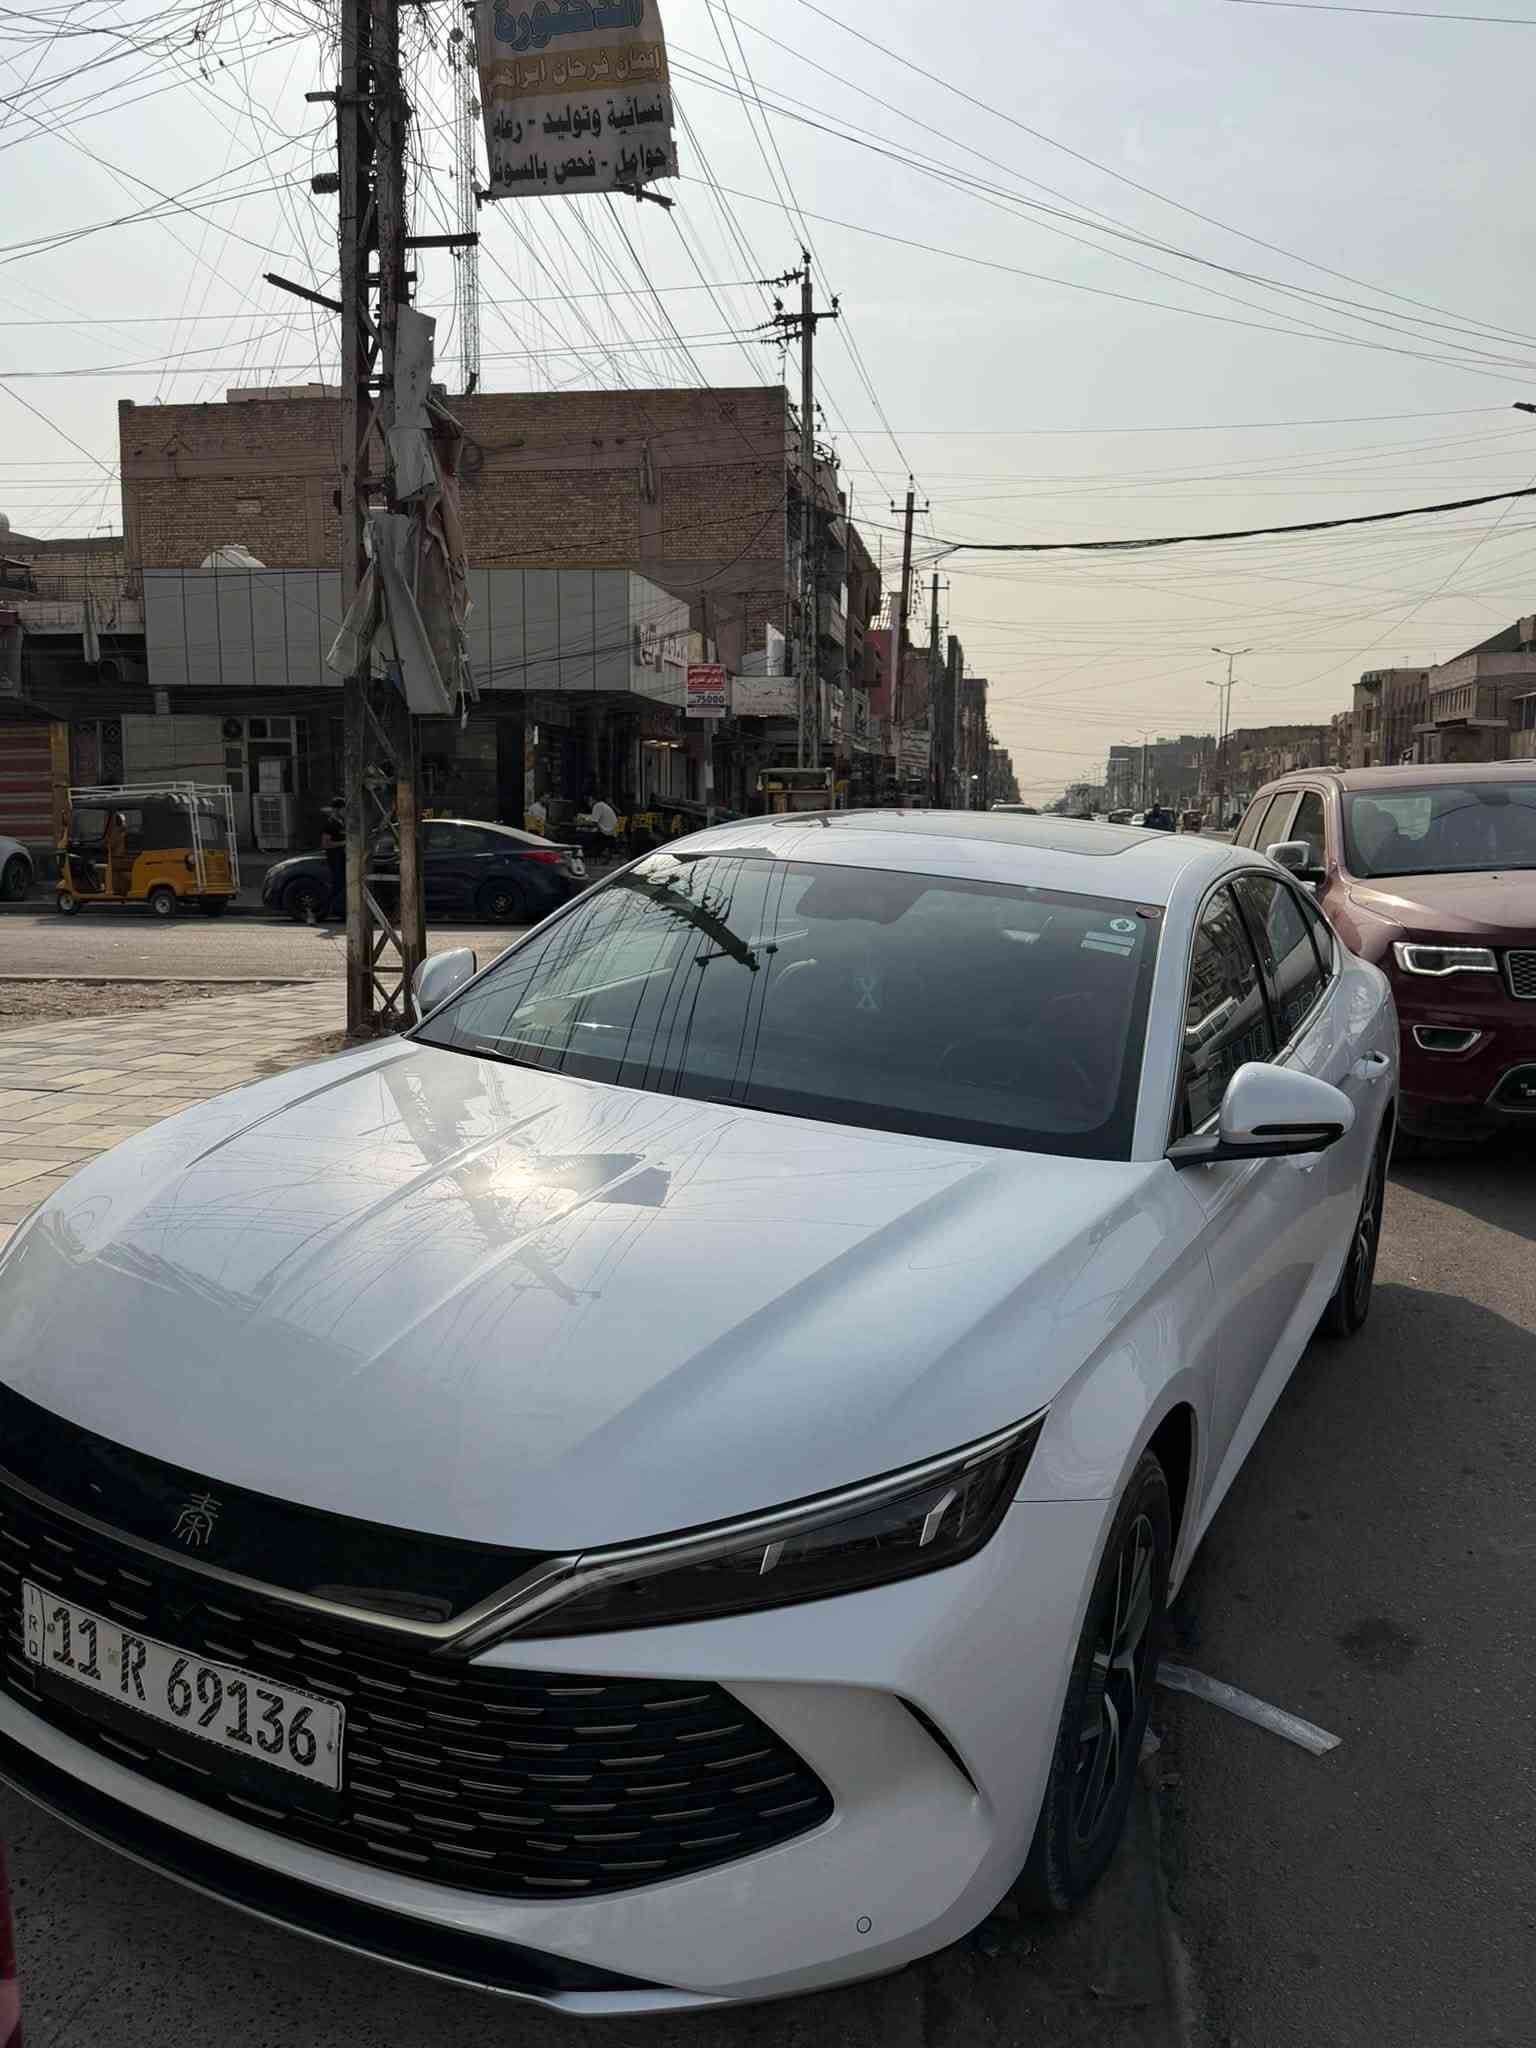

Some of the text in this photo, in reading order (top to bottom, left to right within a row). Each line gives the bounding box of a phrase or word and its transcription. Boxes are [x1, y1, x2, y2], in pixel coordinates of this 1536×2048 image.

[543, 104, 601, 140] وتوليد
[607, 95, 665, 134] نسائية
[554, 150, 596, 185] فحص
[615, 144, 667, 178] حوامل
[52, 1607, 318, 1767] 11 R 69136
